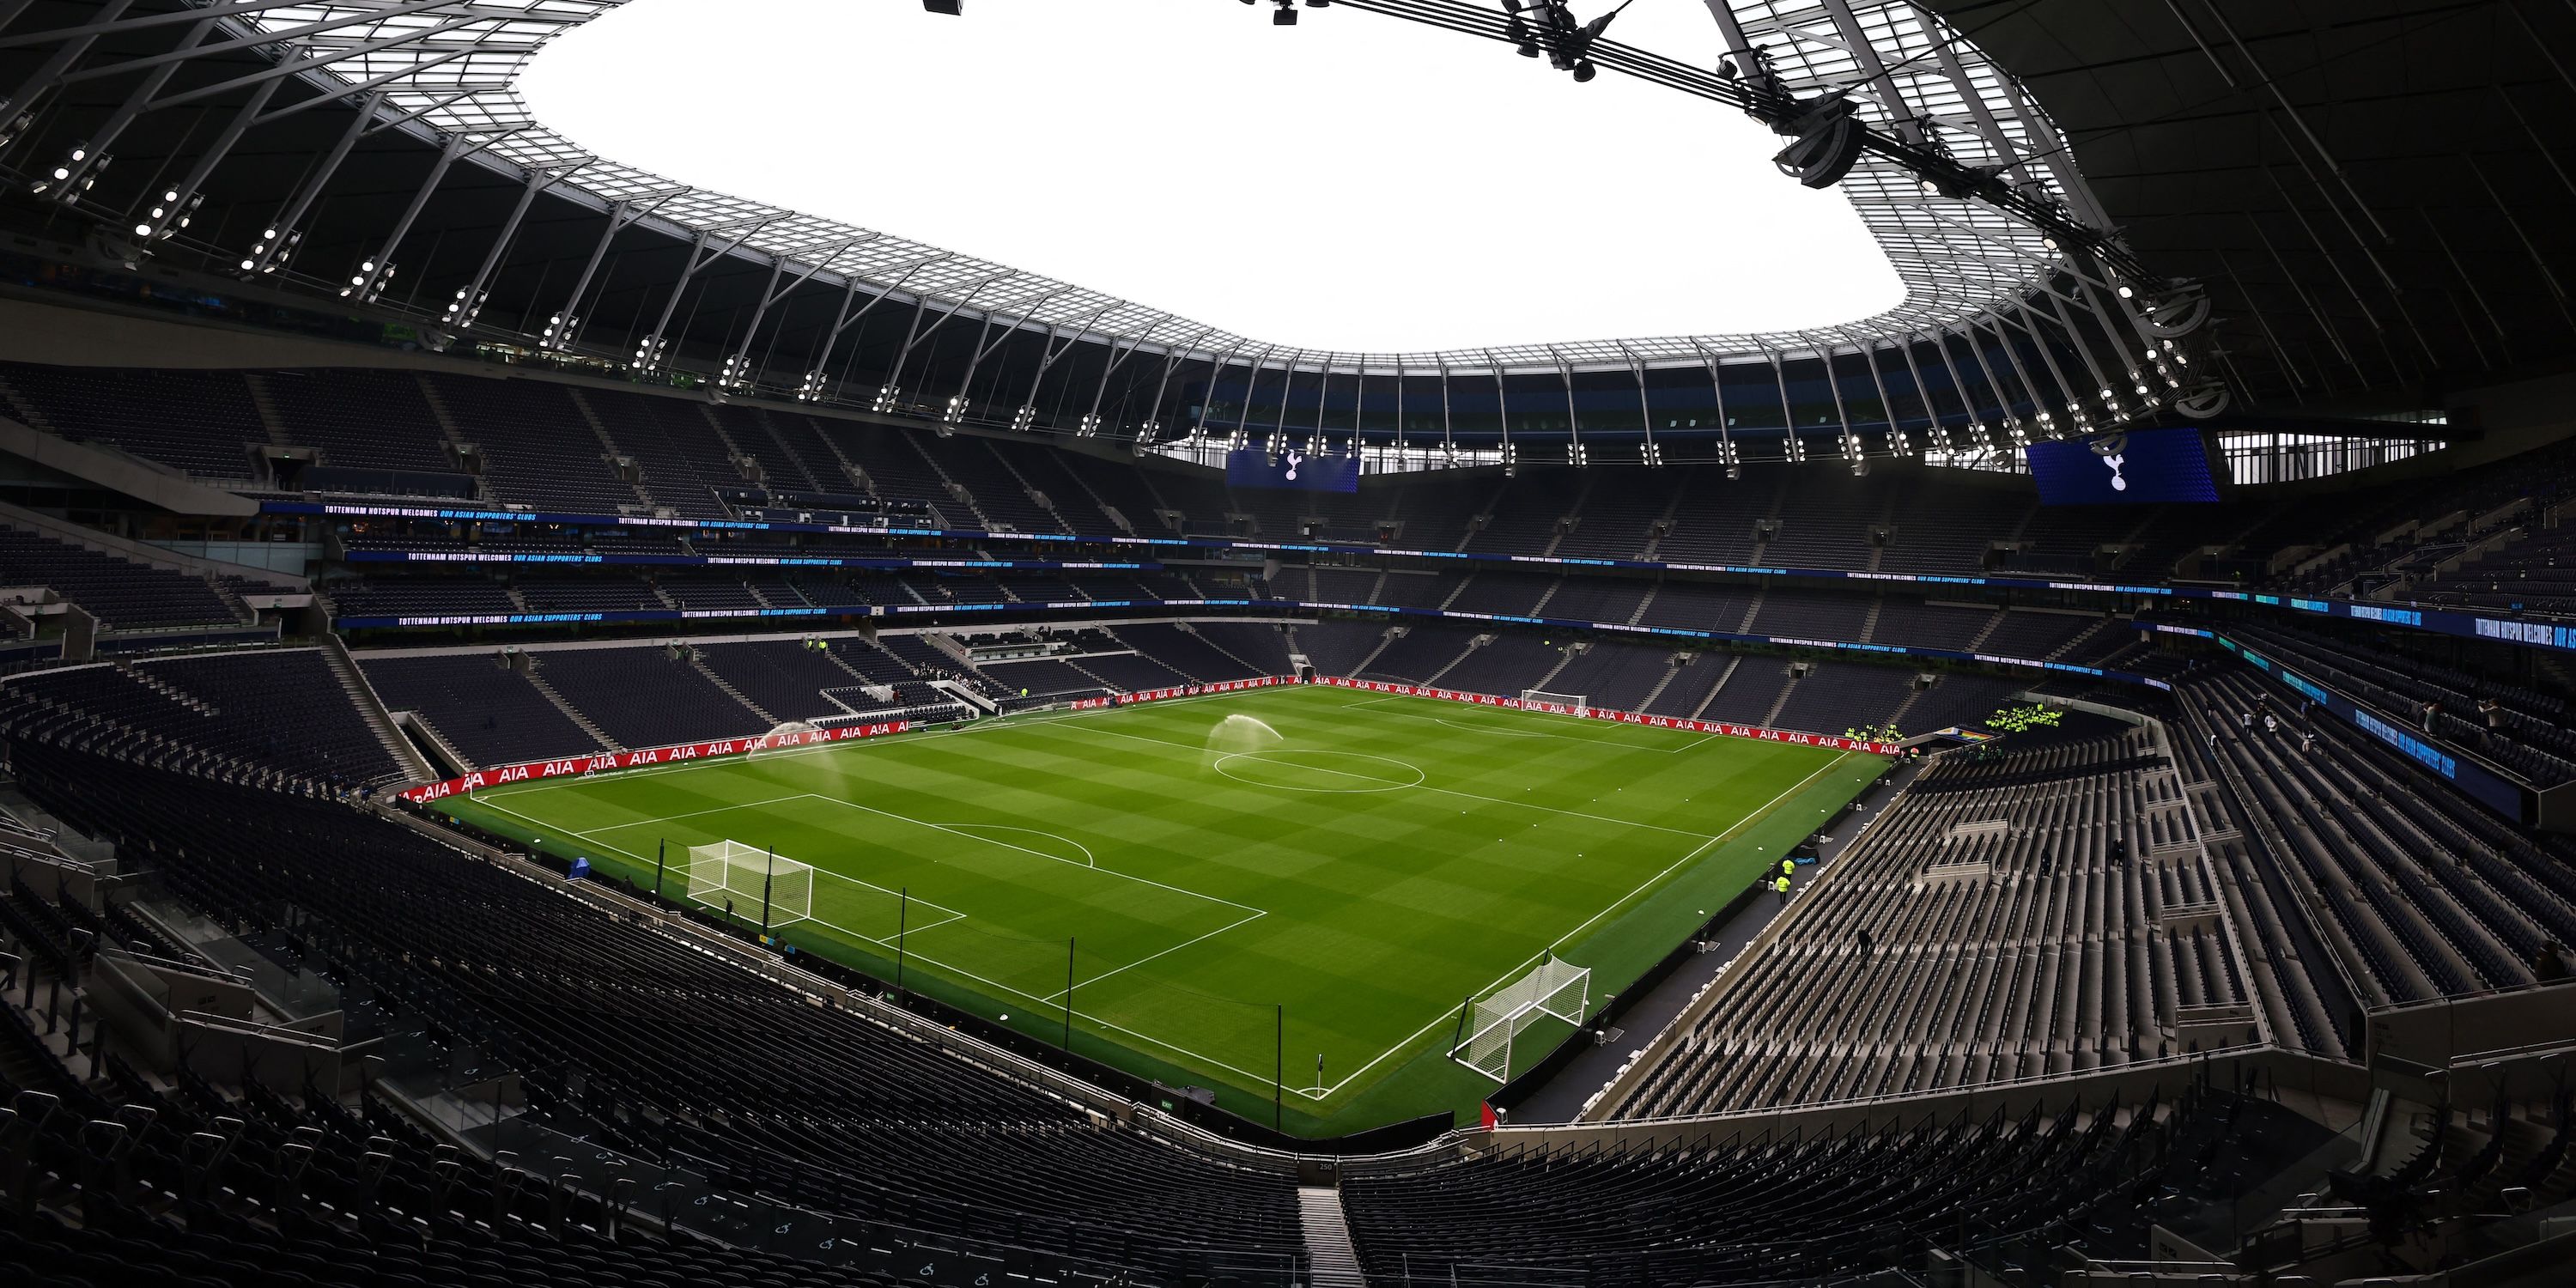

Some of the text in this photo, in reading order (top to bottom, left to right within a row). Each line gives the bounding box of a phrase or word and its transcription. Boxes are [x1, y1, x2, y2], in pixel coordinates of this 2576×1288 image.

[325, 506, 367, 514] TOTTENHAM
[402, 508, 438, 517] WELCOMES
[1083, 699, 1097, 708] AIA
[1156, 690, 1168, 699] AIA
[1172, 689, 1184, 697] AIA
[1204, 684, 1215, 693] AIA
[1219, 683, 1230, 691] AIA
[1234, 681, 1244, 690] AIA
[1376, 683, 1389, 692] AIA
[1395, 686, 1410, 695] AIA
[1416, 688, 1431, 696] AIA
[1437, 690, 1452, 699] AIA
[1459, 694, 1473, 702] AIA
[1480, 696, 1496, 705] AIA
[1503, 699, 1519, 708] AIA
[1526, 702, 1542, 711] AIA
[1598, 711, 1616, 720] AIA
[1624, 714, 1642, 723] AIA
[1649, 717, 1668, 726] AIA
[1675, 720, 1695, 730] AIA
[1703, 724, 1722, 733] AIA
[1731, 727, 1751, 737] AIA
[1759, 731, 1779, 740] AIA
[1788, 734, 1809, 744] AIA
[1818, 738, 1839, 747] AIA
[1849, 741, 1871, 751] AIA
[423, 782, 450, 801] AIA
[499, 766, 529, 783] AIA
[543, 761, 574, 776] AIA
[629, 751, 658, 765] AIA
[669, 747, 696, 760] AIA
[708, 742, 732, 756] AIA
[777, 734, 800, 746] AIA
[810, 731, 831, 742] AIA
[840, 727, 861, 738] AIA
[1162, 1101, 1172, 1109] EXIT
